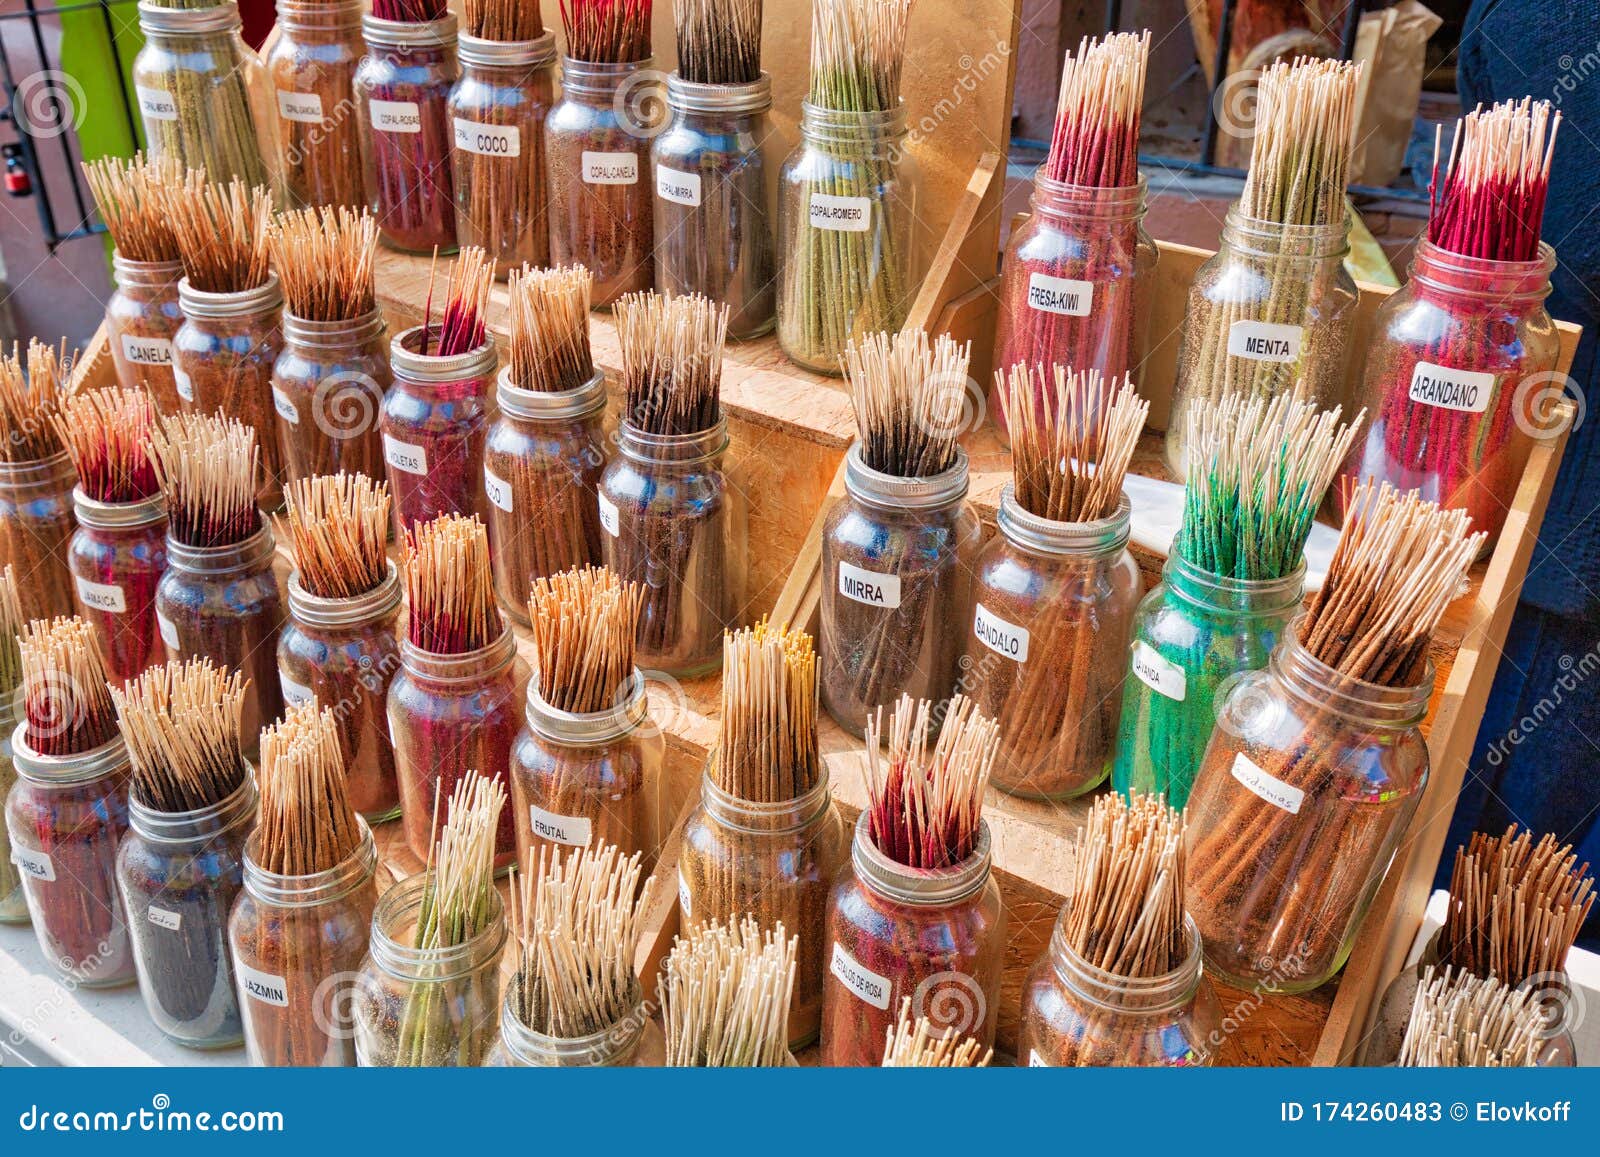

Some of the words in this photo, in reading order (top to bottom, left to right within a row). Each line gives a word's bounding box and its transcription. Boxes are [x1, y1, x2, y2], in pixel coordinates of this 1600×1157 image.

[477, 134, 508, 154] COCO
[590, 166, 635, 179] COPAL-CANELA
[810, 203, 862, 221] COPAL-ROMERO
[1030, 286, 1080, 311] FRESA-KIWI
[129, 345, 172, 363] CANELA
[1245, 335, 1290, 356] MENTA
[1411, 374, 1478, 408] ARANDANO
[844, 575, 884, 602] MIRRA
[976, 616, 1019, 655] SANDALO
[535, 819, 568, 841] FRUTAL
[244, 975, 283, 1001] JAZMIN
[835, 954, 856, 983] PETALOS
[856, 974, 865, 991] DE
[864, 980, 882, 1000] ROSA
